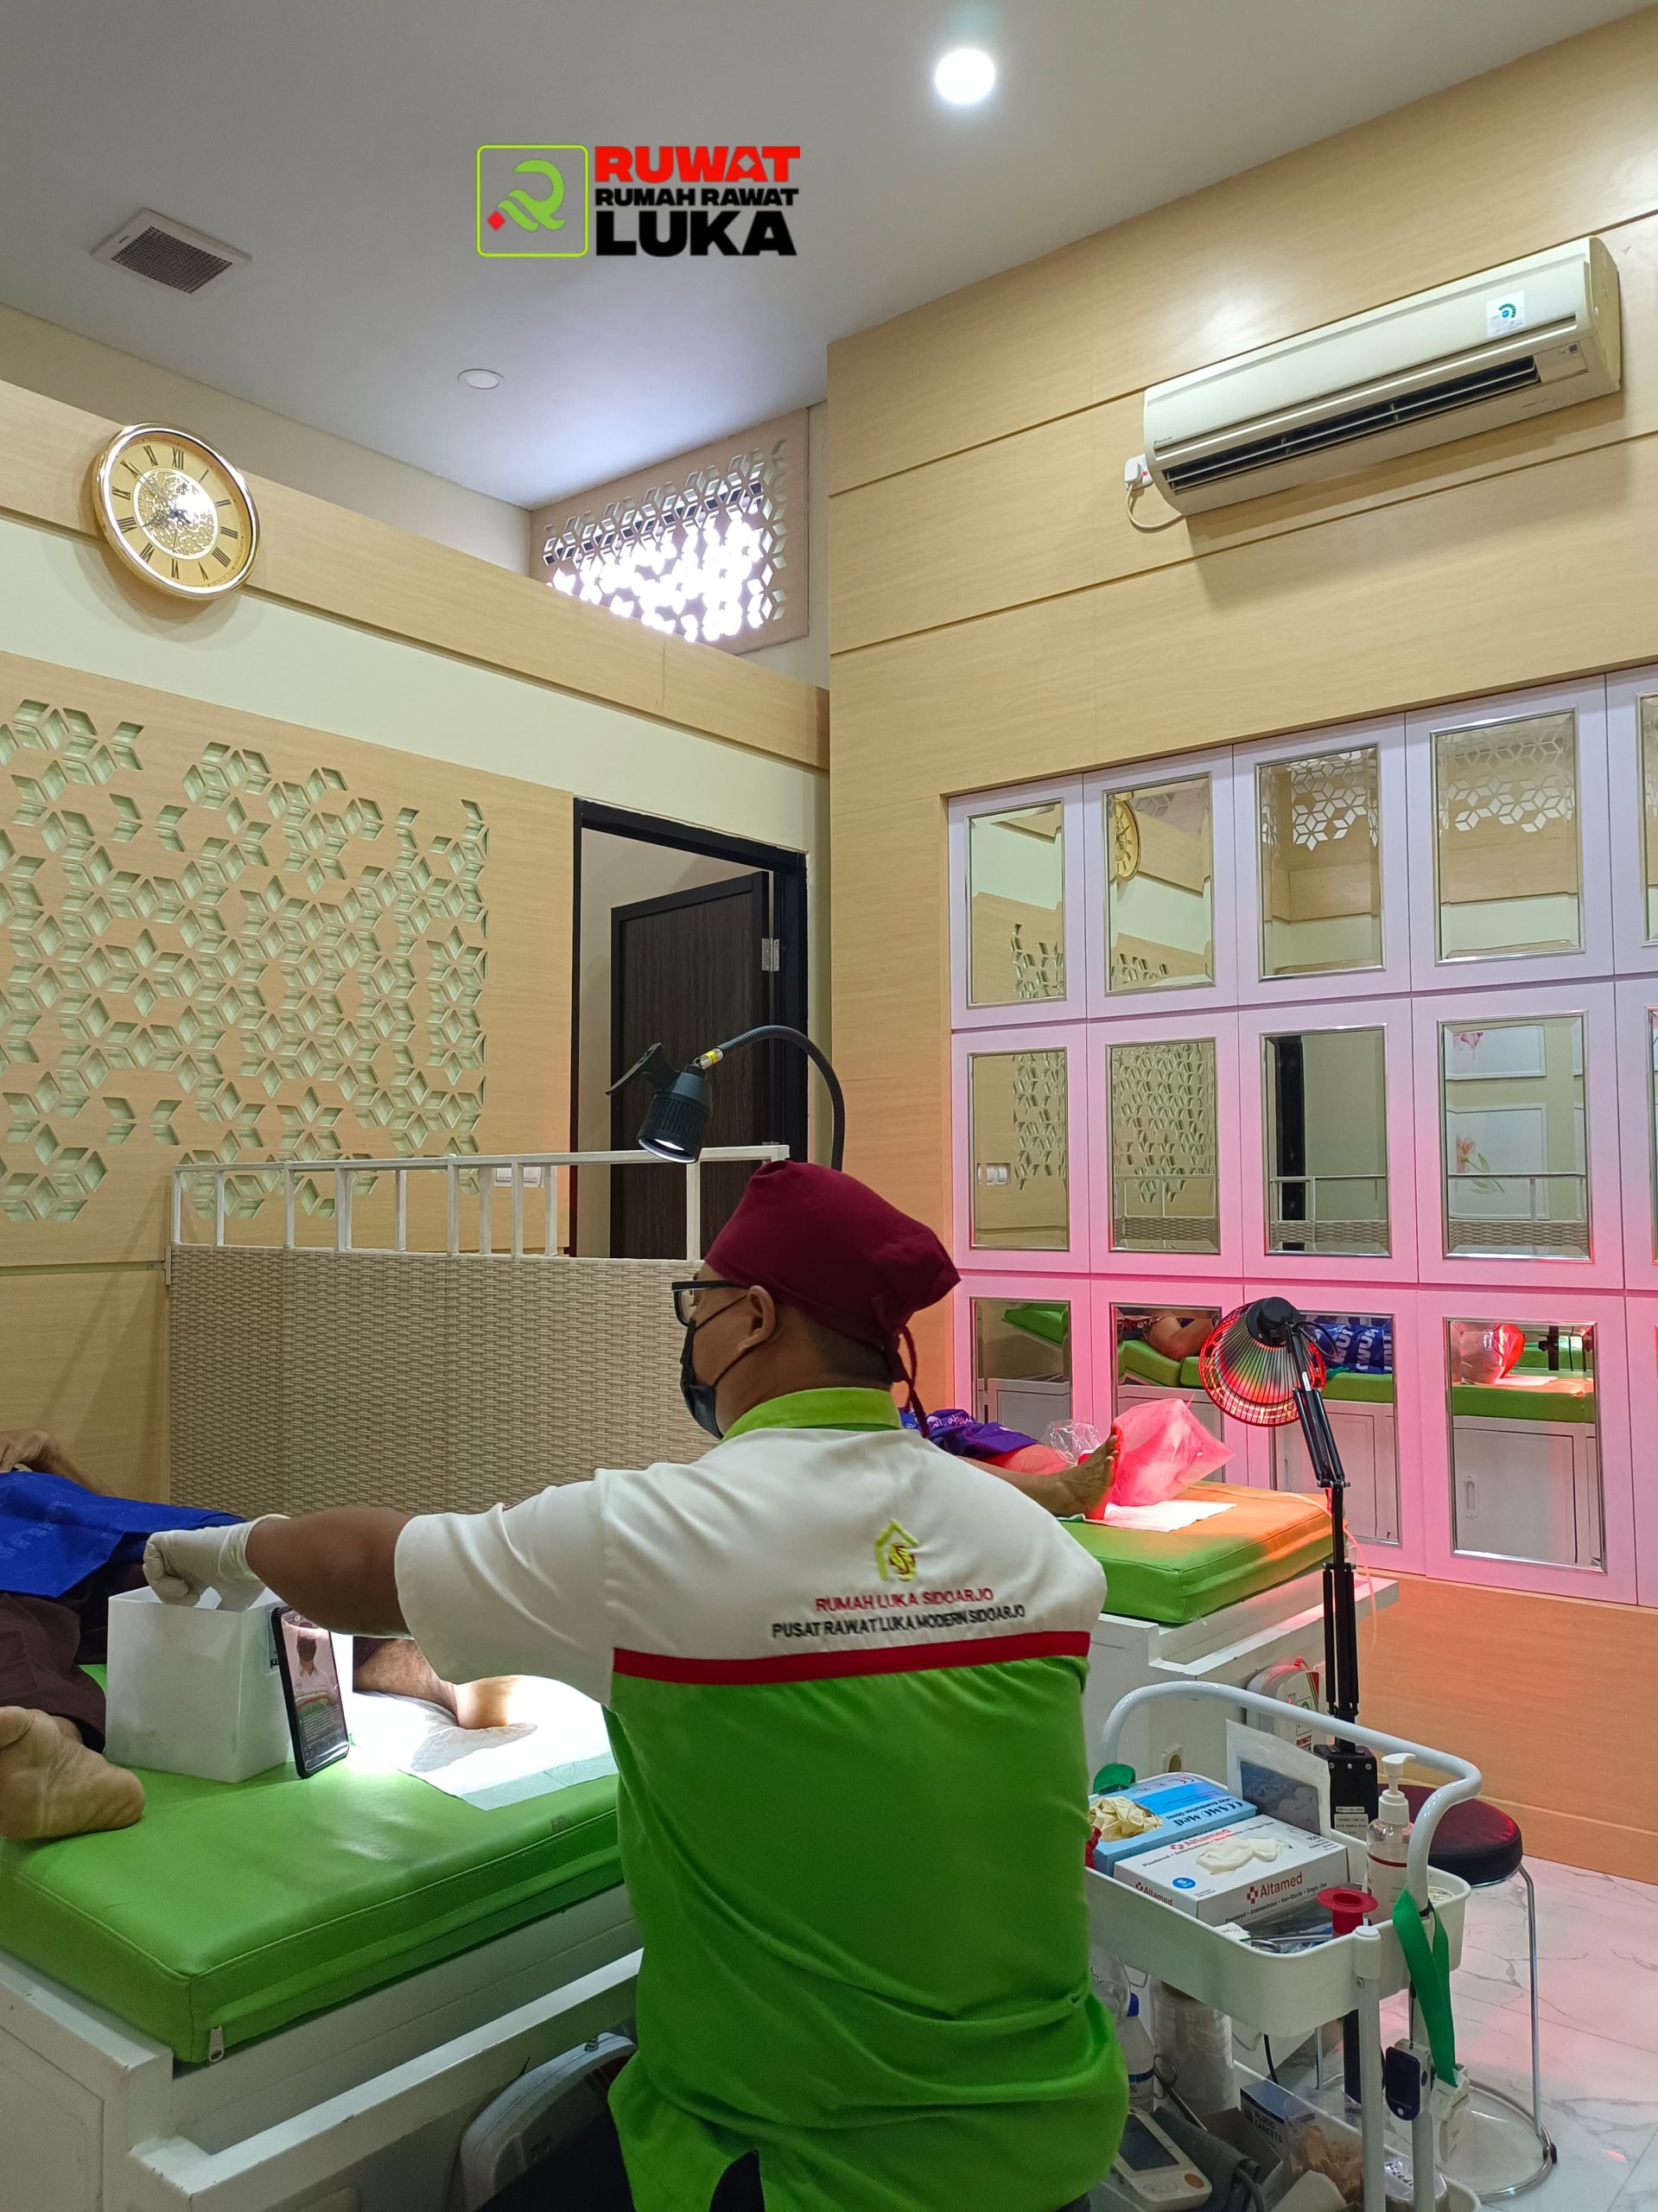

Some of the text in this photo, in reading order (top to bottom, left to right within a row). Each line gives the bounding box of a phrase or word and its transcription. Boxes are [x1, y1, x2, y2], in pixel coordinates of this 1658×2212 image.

[816, 1596, 875, 1612] RUMAH
[877, 1592, 919, 1609] LUKA
[772, 1622, 822, 1639] PUSAT
[823, 1618, 878, 1636] RAWAT
[879, 1615, 916, 1632] LUKA
[916, 1611, 969, 1629] MODERN
[1166, 1811, 1185, 1821] Gloves
[1173, 1815, 1202, 1827] Med
[1185, 1828, 1230, 1847] Altamed
[1261, 1872, 1303, 1898] Altamed
[1143, 1886, 1173, 1906] Altamed
[1255, 2110, 1275, 2129] BLOOD
[1255, 2121, 1283, 2144] LANCETS
